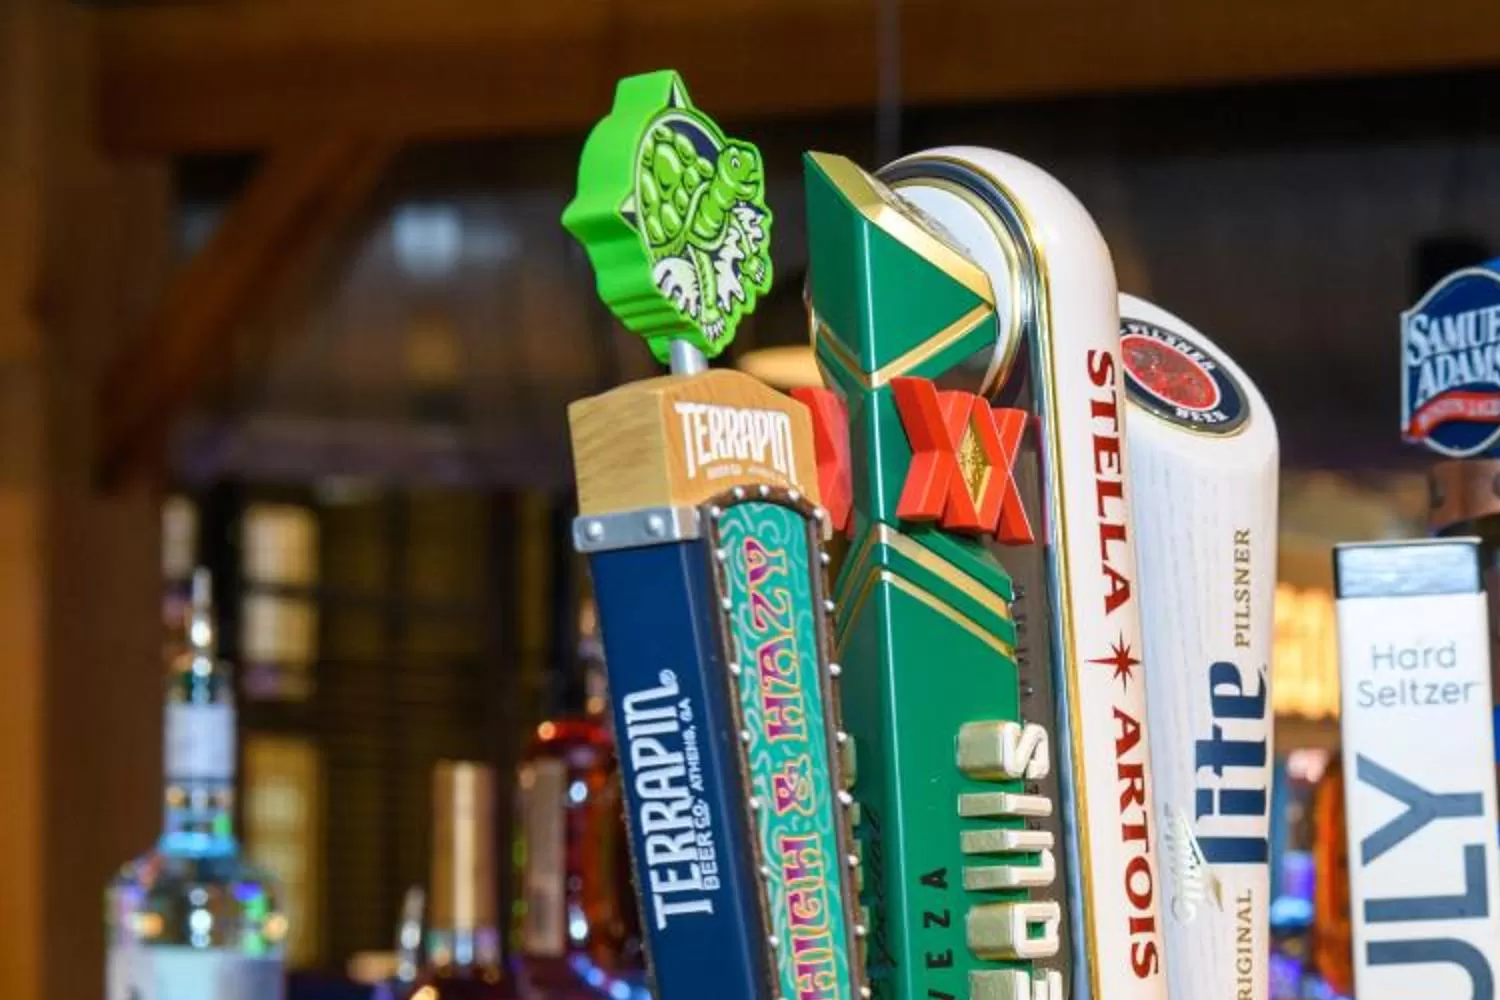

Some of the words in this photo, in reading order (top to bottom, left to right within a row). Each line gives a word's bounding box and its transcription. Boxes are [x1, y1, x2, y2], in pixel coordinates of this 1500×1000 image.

[673, 401, 798, 488] TERRAPIN
[1234, 528, 1252, 649] PILSNER
[743, 536, 807, 744] HAZY
[1087, 350, 1132, 616] STELLA
[1112, 705, 1160, 980] ARTOIS
[1370, 641, 1457, 672] Hard
[677, 697, 694, 723] GA
[1357, 680, 1482, 709] Seltzer
[622, 680, 715, 930] TERRAPIN
[772, 754, 817, 817] &
[696, 831, 721, 891] BEER
